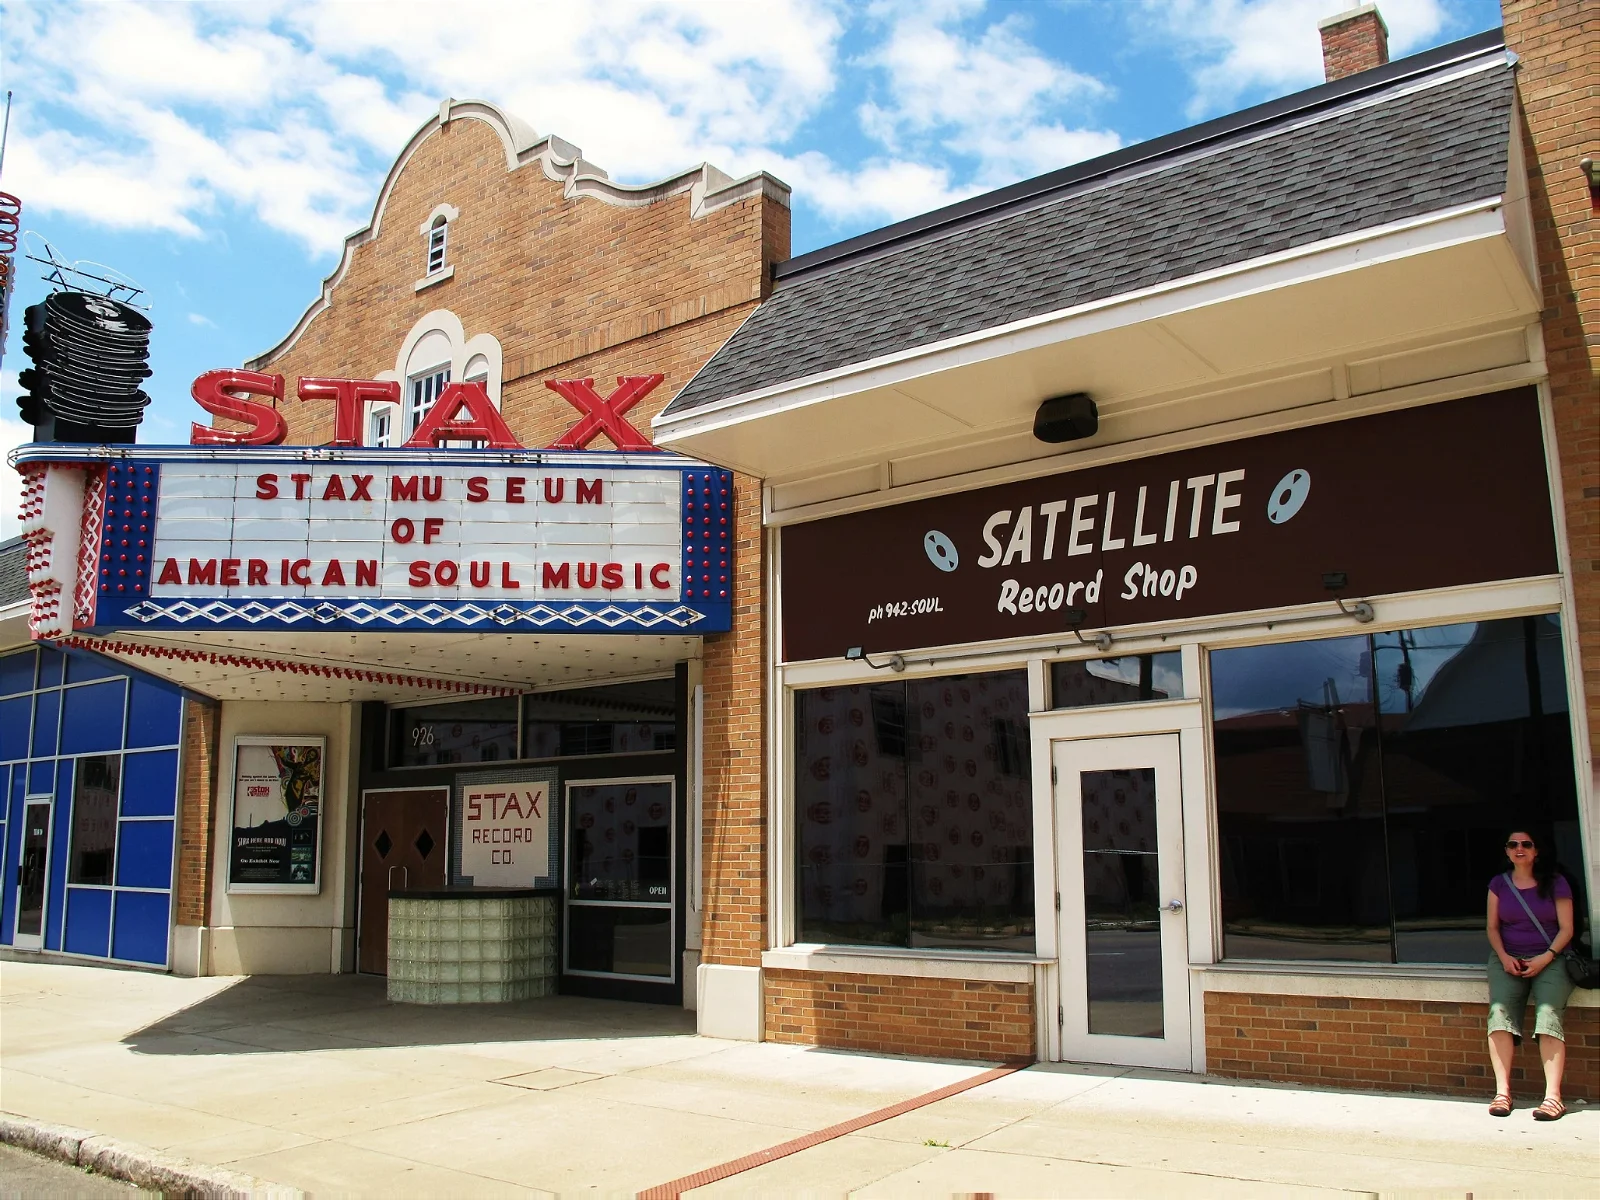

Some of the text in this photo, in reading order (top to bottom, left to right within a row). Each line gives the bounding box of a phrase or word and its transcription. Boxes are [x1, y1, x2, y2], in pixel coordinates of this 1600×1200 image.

[190, 368, 664, 451] STAX
[256, 473, 374, 502] STAX
[392, 518, 443, 545] OF
[978, 468, 1246, 569] SATELLITE
[159, 557, 671, 590] AMERICAN SOUL MUSIC
[998, 561, 1198, 616] Record Shop
[868, 597, 944, 624] ph 942-SOUL
[411, 726, 435, 746] 926
[467, 790, 543, 821] STAX
[472, 827, 533, 844] RECORD
[491, 850, 514, 865] CO.
[649, 886, 667, 896] OPEN
